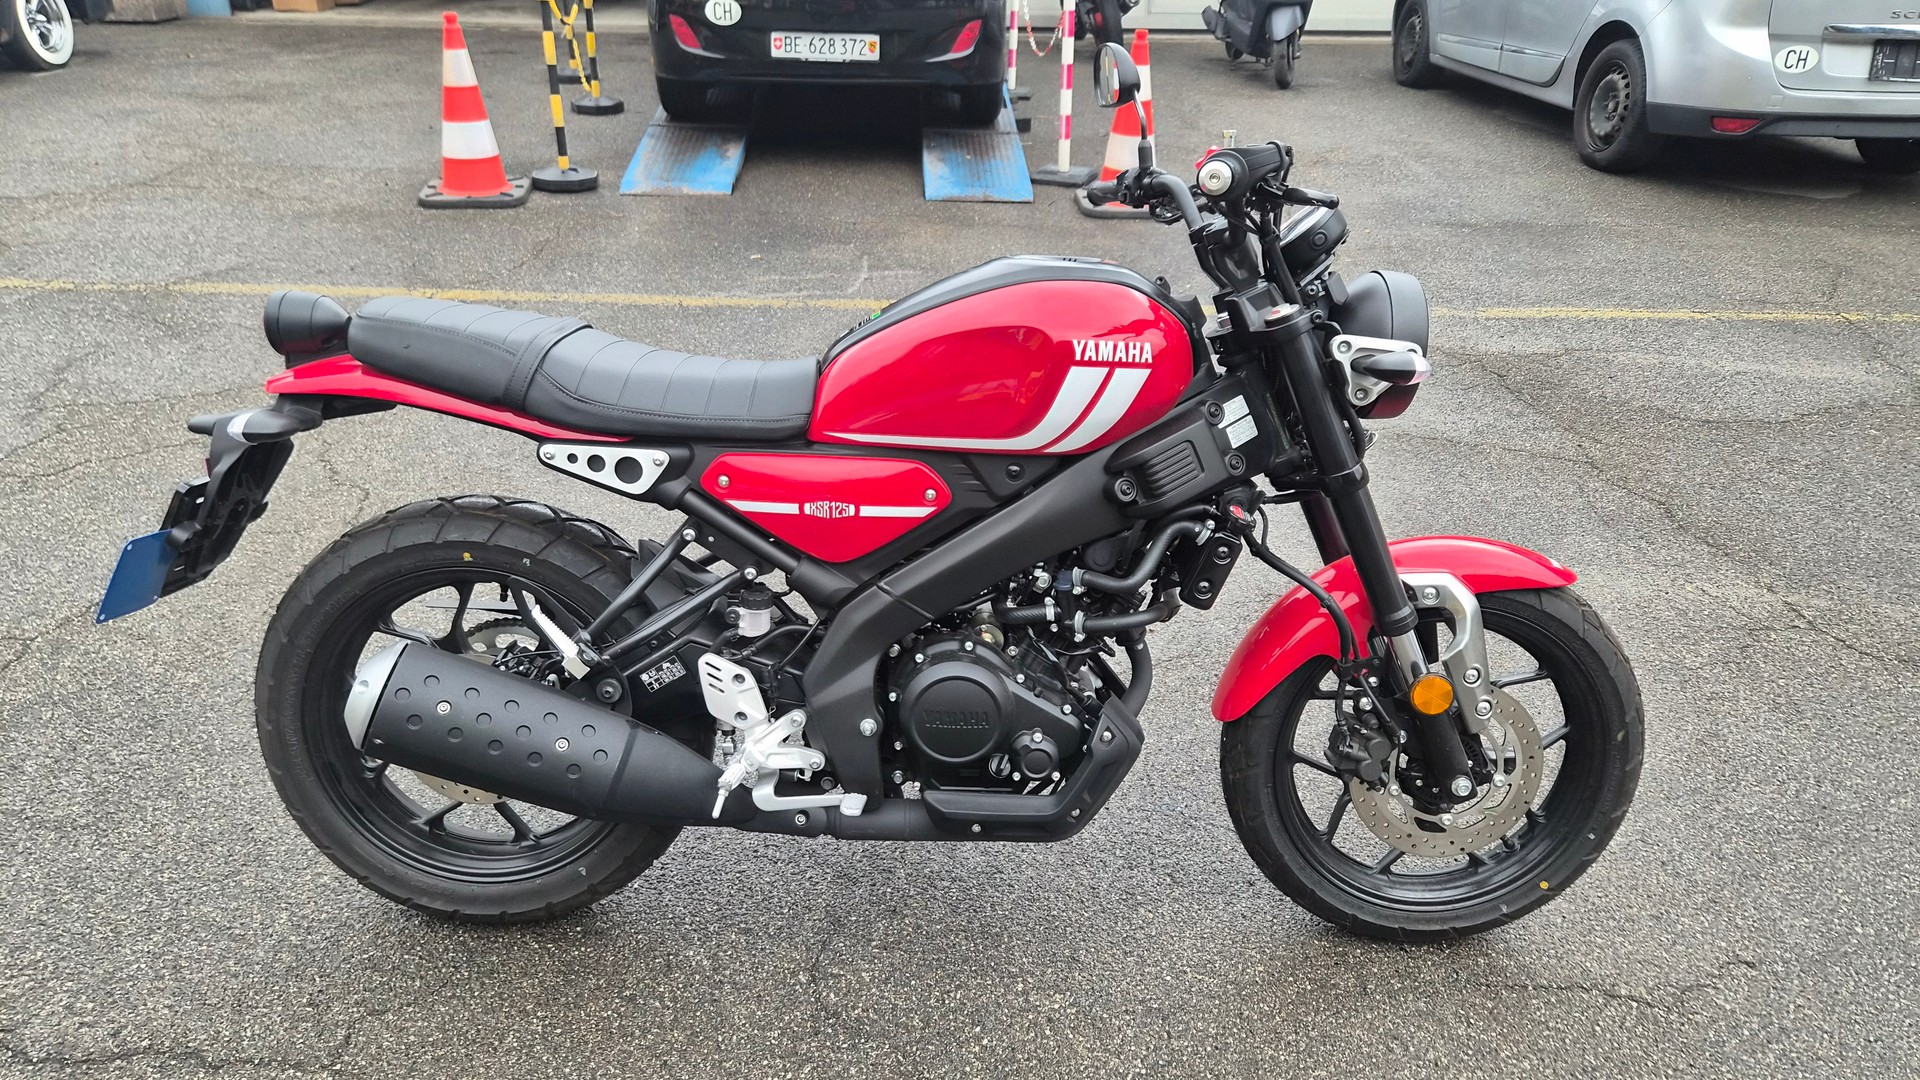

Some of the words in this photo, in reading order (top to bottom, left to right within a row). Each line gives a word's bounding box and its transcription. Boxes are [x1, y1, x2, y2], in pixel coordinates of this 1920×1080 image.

[713, 2, 734, 22] CH
[1890, 9, 1920, 19] SC
[1783, 49, 1810, 70] CH
[1072, 339, 1153, 363] YAMAHA
[810, 500, 850, 519] XSR125
[922, 709, 990, 729] YAMAHA
